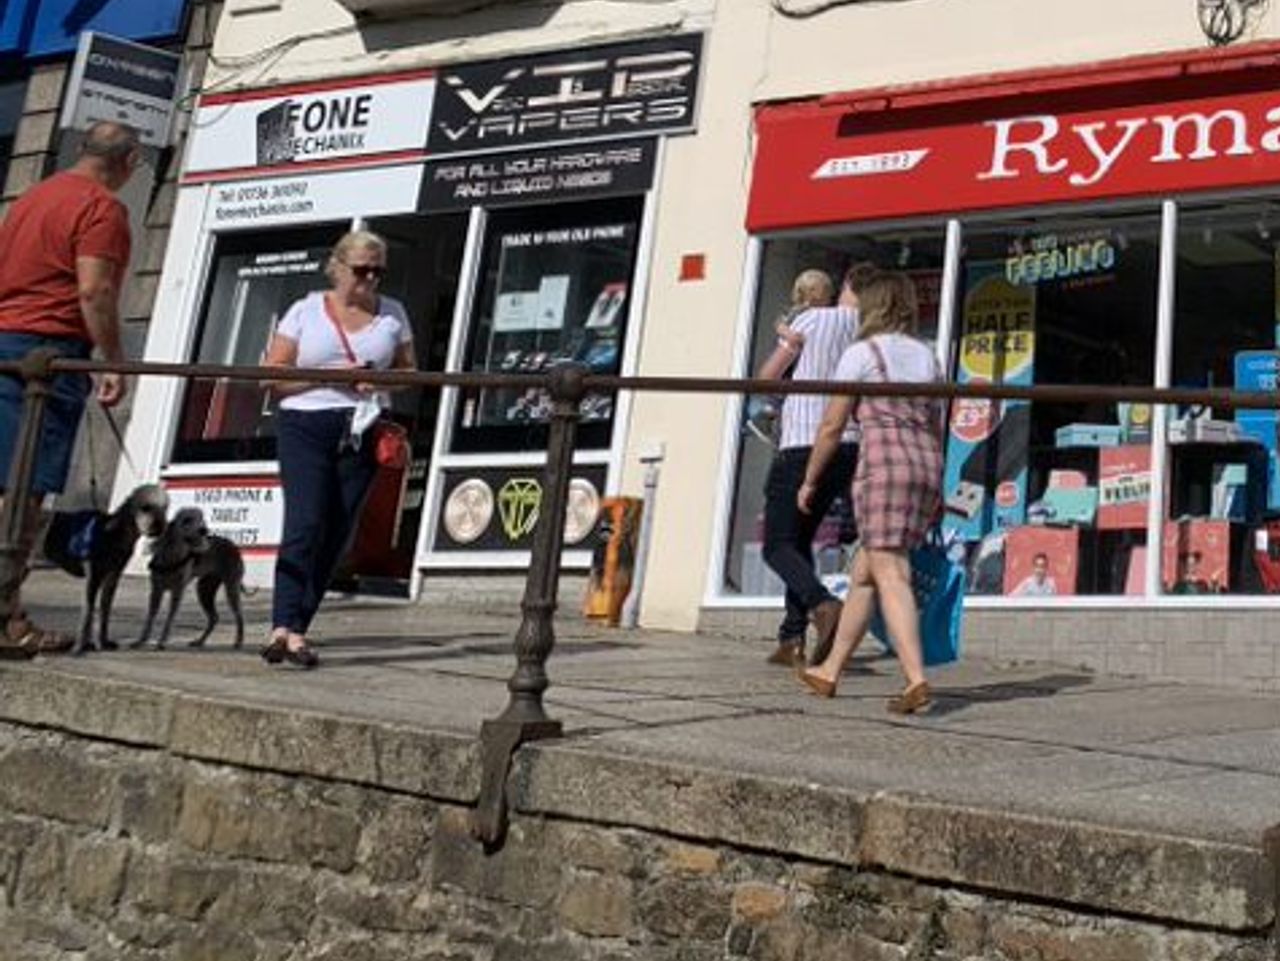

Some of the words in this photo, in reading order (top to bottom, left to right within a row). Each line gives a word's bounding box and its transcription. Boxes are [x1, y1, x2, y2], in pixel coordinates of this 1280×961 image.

[443, 50, 695, 114] VIP
[284, 94, 373, 133] FONE
[438, 96, 690, 141] VAPERS
[434, 165, 467, 181] FOR
[469, 161, 501, 179] ALL
[503, 157, 547, 175] YOUR
[551, 147, 643, 171] HARDWARE
[453, 182, 489, 199] AND
[491, 174, 553, 196] LIQUID
[967, 311, 1032, 336] HALF
[965, 333, 1029, 357] PRICE
